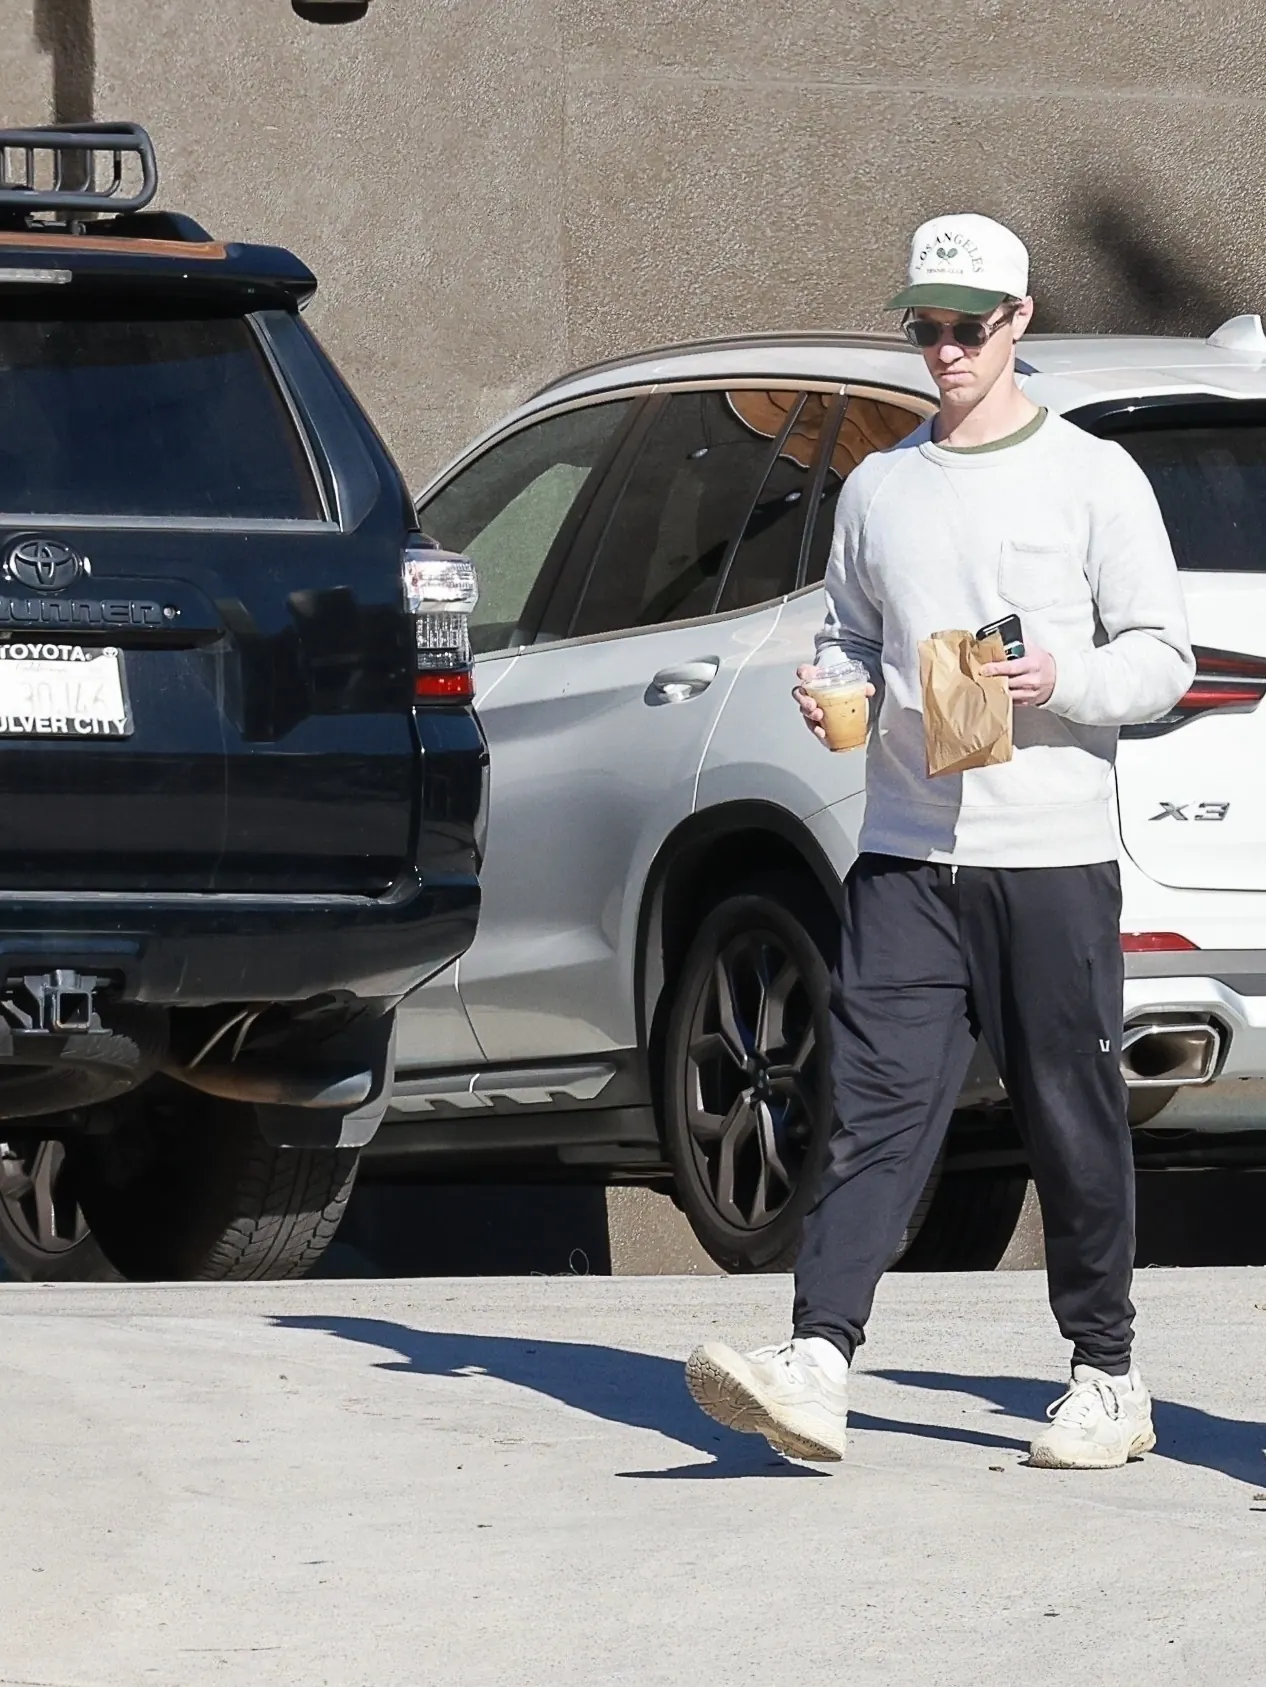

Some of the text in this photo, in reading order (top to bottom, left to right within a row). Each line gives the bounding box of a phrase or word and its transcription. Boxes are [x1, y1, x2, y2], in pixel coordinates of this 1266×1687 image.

[934, 231, 985, 273] ANGELES
[0, 643, 86, 662] TOYOTA
[74, 717, 127, 734] CITY
[1148, 801, 1231, 821] X3
